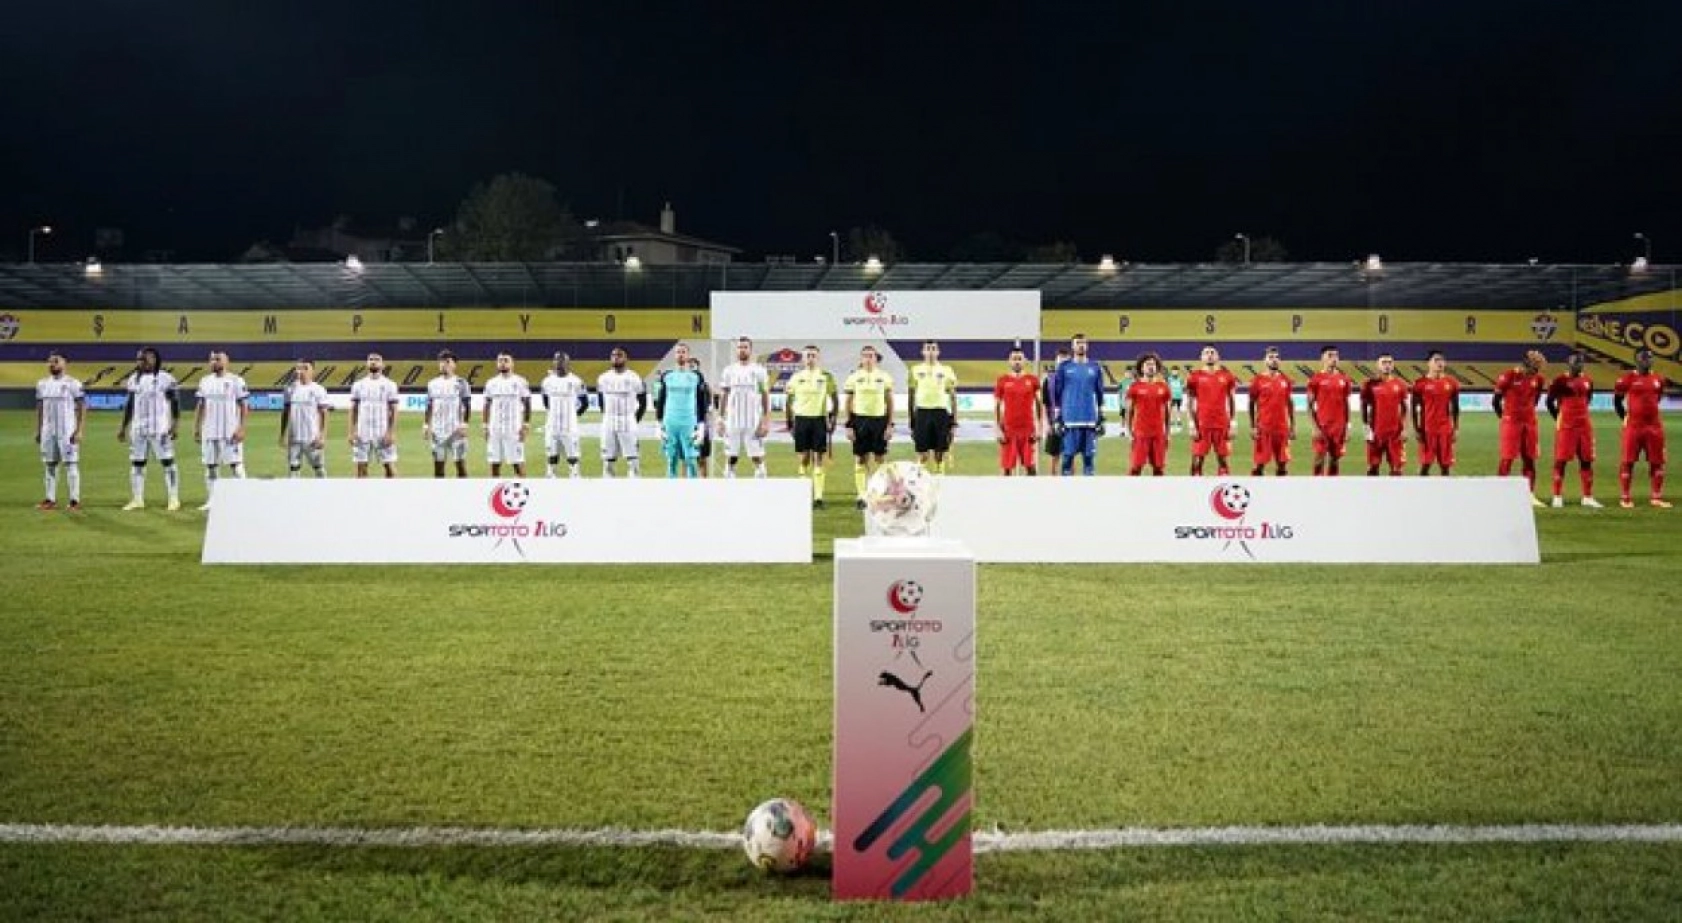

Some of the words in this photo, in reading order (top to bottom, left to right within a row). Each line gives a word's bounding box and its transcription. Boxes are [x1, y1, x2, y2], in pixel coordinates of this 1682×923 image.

[448, 524, 530, 538] SPORTOTO
[1173, 525, 1255, 539] SPORTOTO
[869, 620, 943, 633] SPORTOTO
